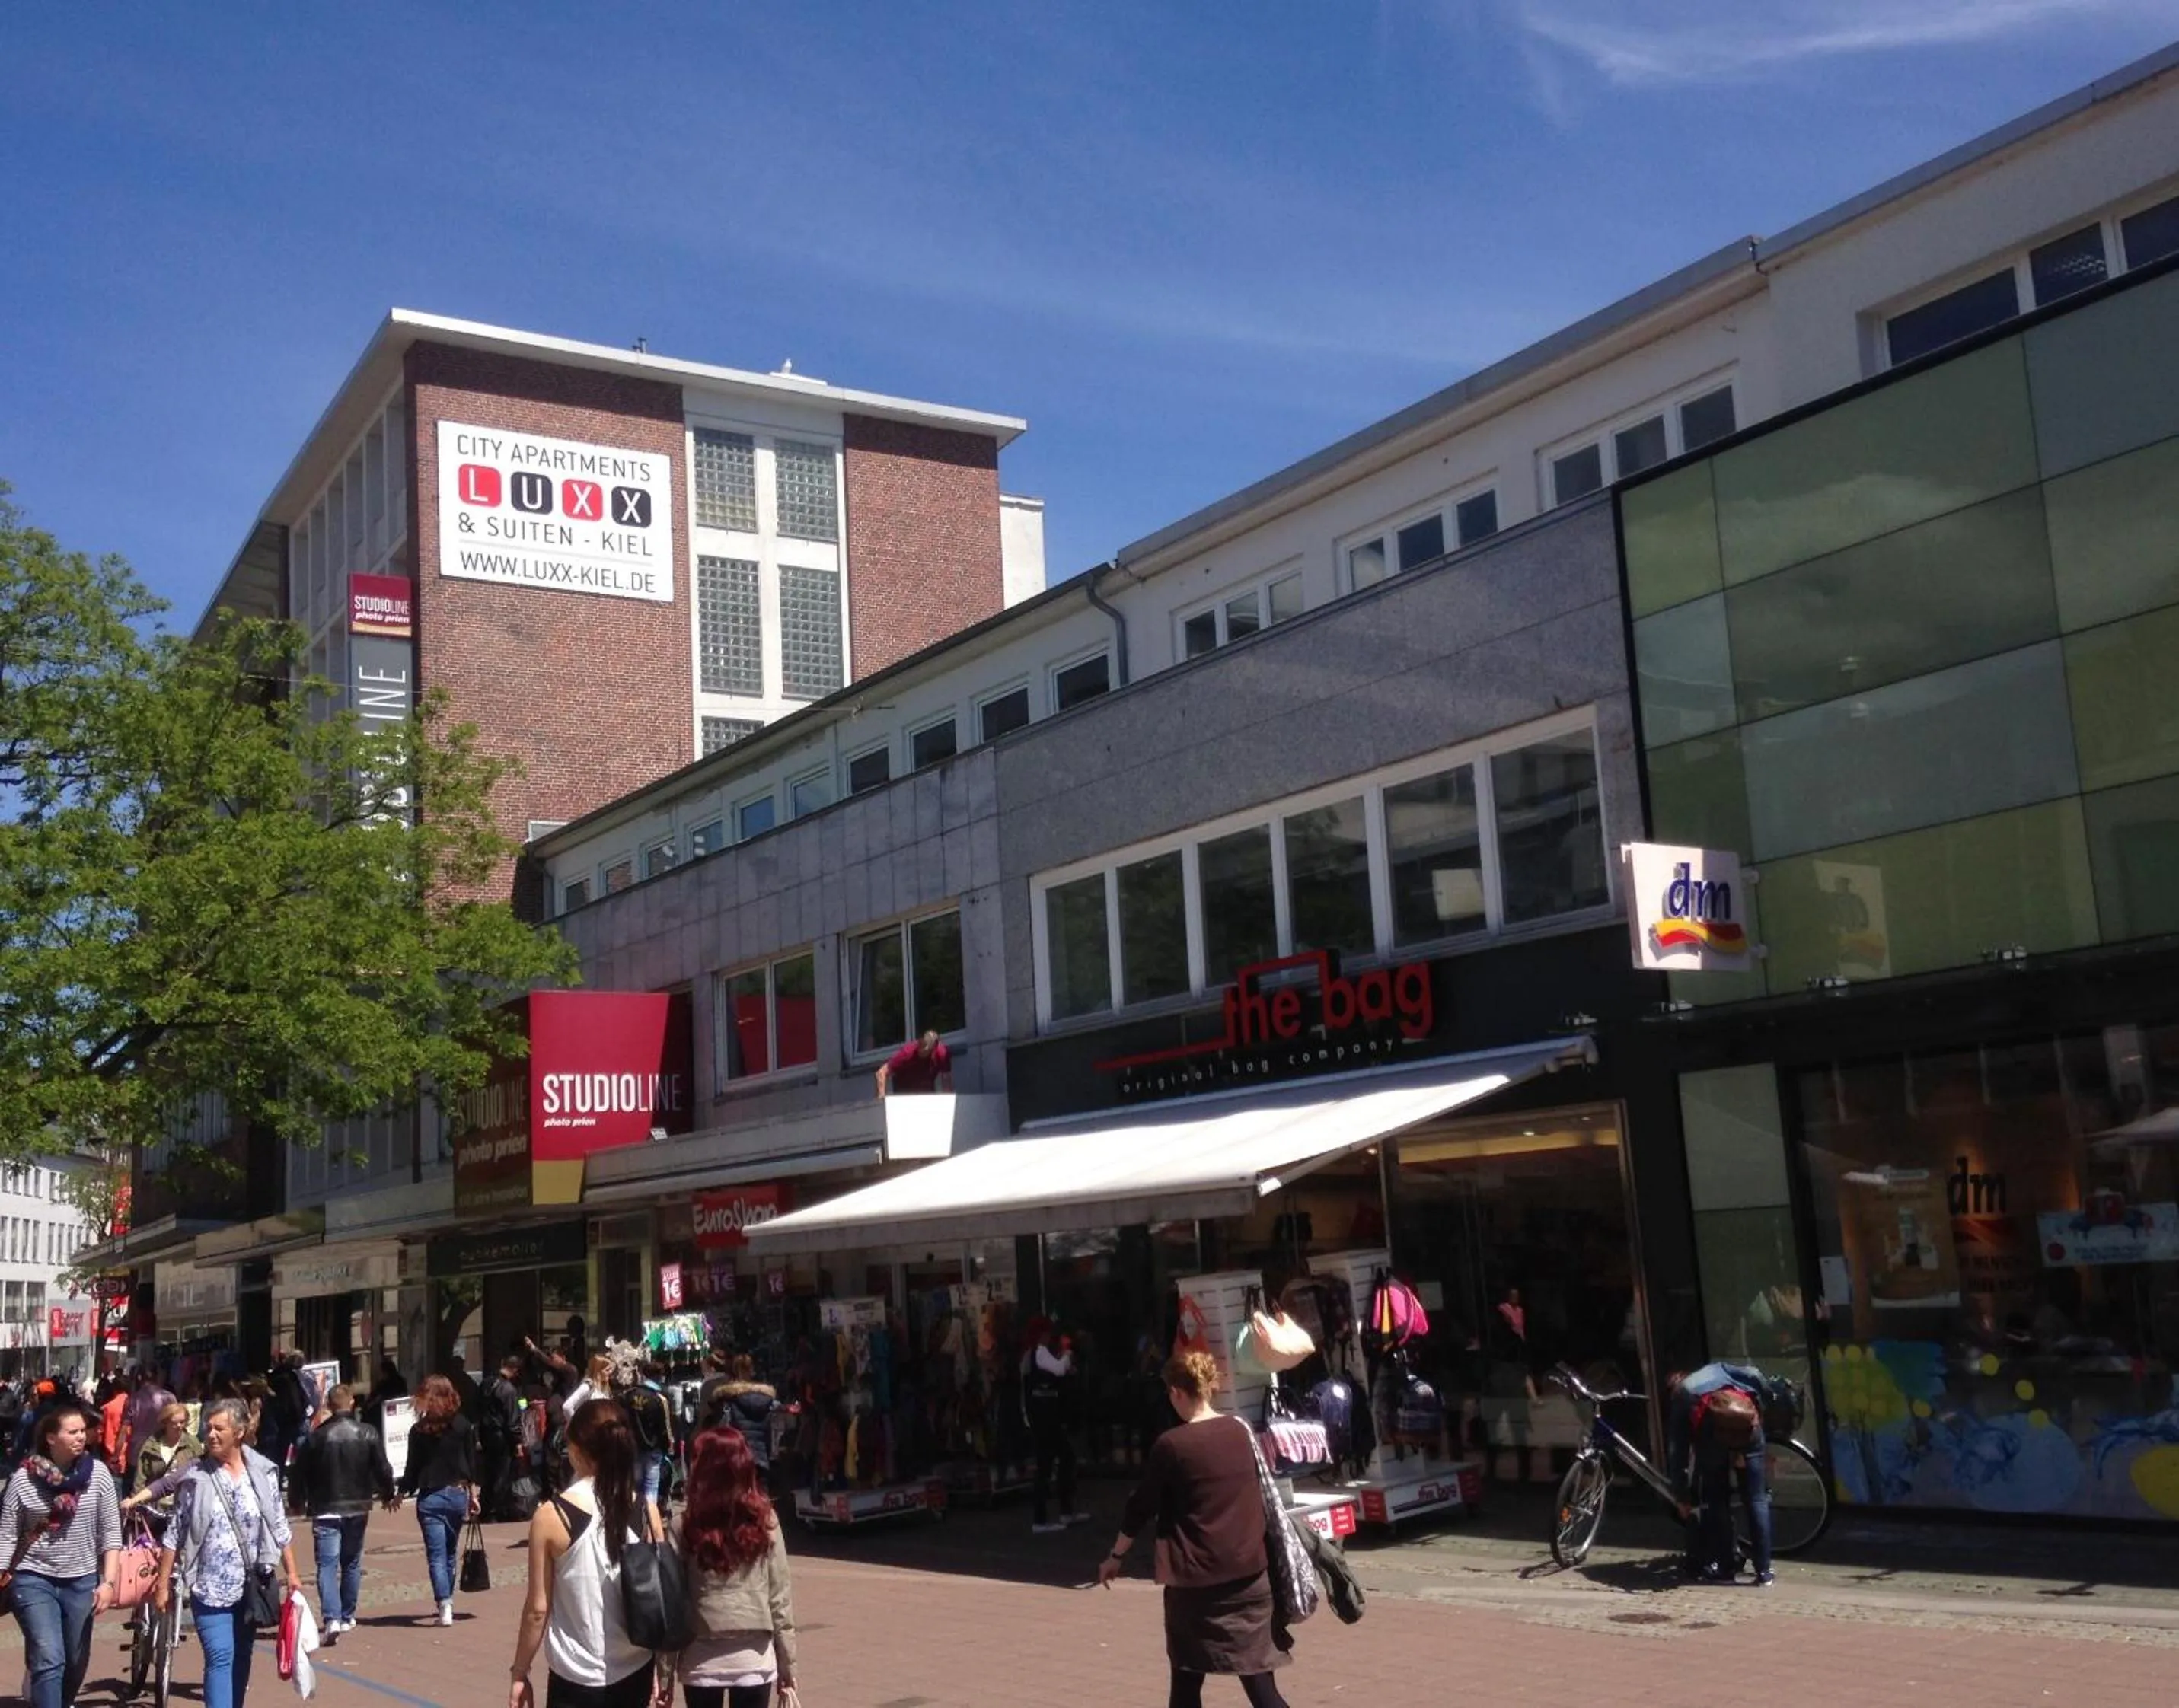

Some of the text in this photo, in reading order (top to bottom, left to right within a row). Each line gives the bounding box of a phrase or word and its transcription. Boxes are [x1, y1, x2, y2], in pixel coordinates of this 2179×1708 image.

[457, 434, 651, 482] CITY APARTMENTS
[458, 511, 476, 534] &
[487, 516, 573, 546] SUITEN
[601, 531, 653, 557] KIEL
[460, 550, 656, 594] WWW.LUXX-KIEL.DE
[354, 595, 409, 614] STUDIOLINE
[356, 611, 383, 620] photo
[1668, 862, 1730, 919] dm
[1223, 948, 1435, 1047] the bag
[1121, 1037, 1395, 1094] original bag company
[542, 1074, 683, 1114] STUDIOLINE
[544, 1116, 596, 1128] photo prien
[458, 1132, 528, 1170] photo prien
[1947, 1156, 2006, 1214] dm
[662, 1279, 681, 1302] 1€
